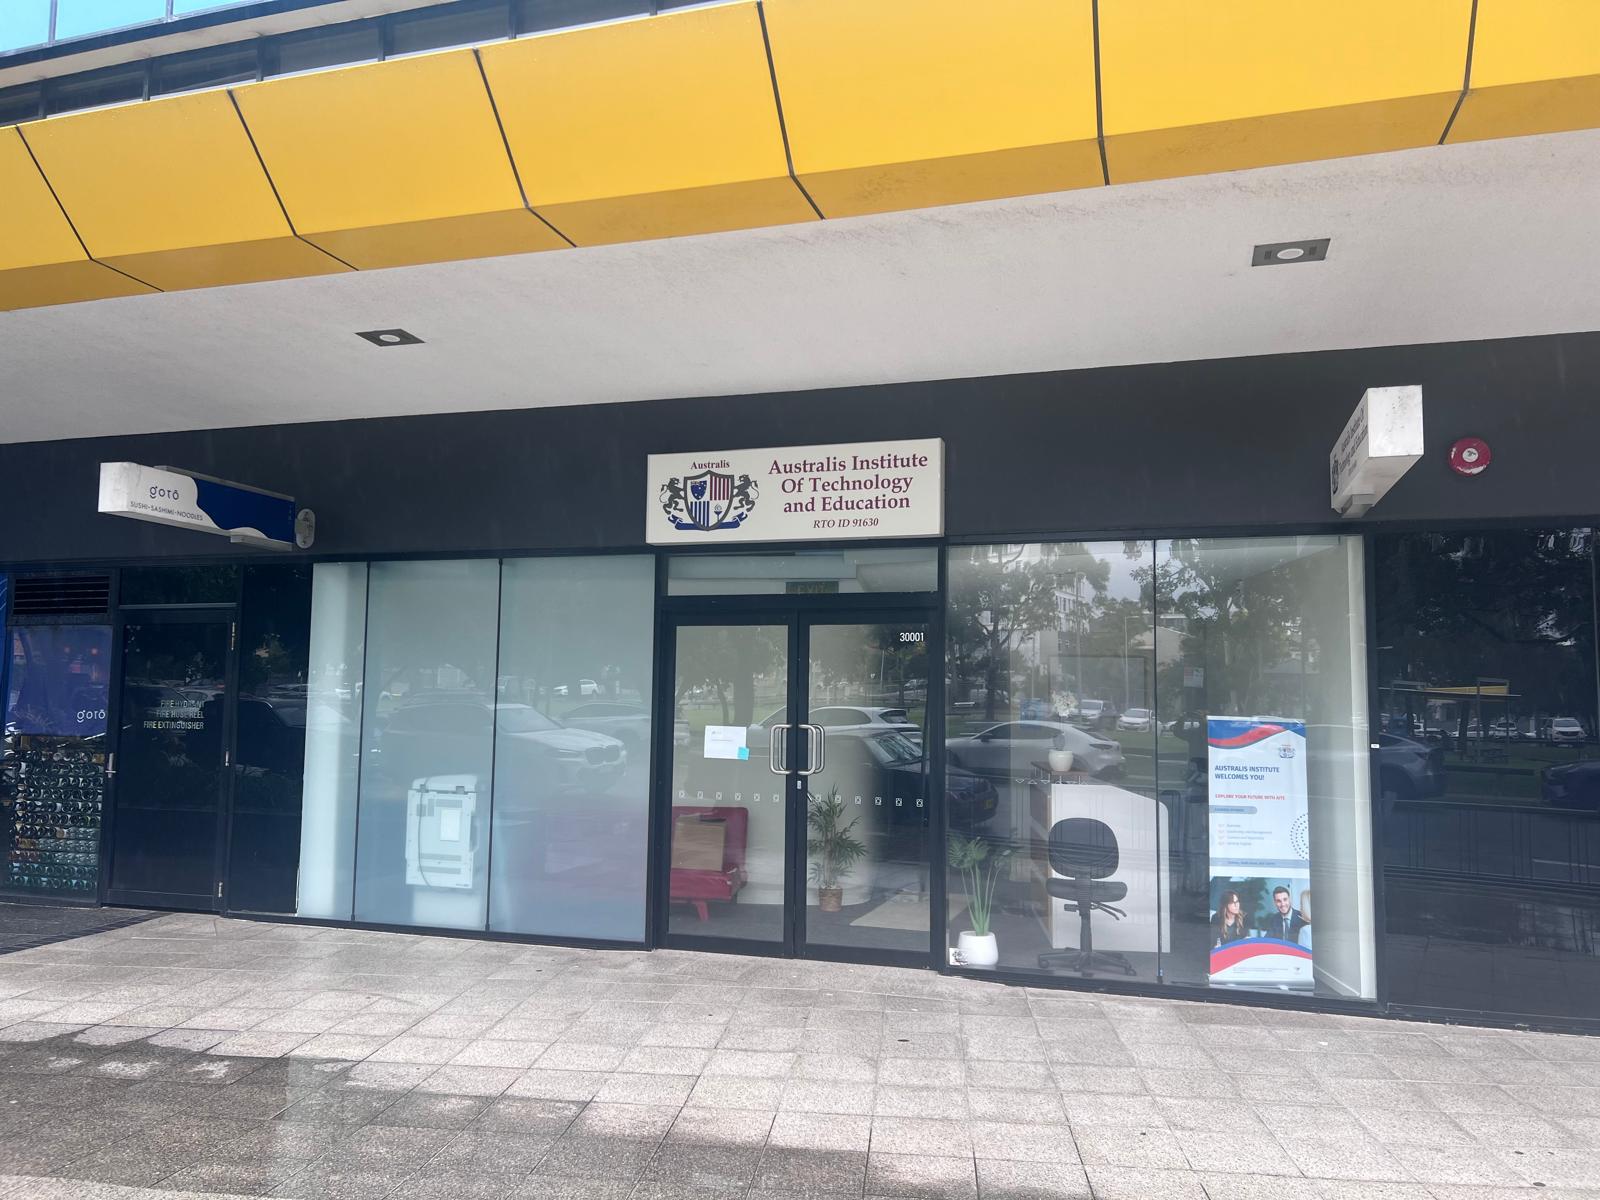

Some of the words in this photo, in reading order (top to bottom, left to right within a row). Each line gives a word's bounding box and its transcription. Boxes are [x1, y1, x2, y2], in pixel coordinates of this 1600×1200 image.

[690, 460, 730, 470] Australis
[768, 457, 846, 474] Australis
[852, 454, 928, 470] Institute
[782, 478, 804, 494] Of
[809, 474, 913, 492] Technology
[784, 498, 815, 512] and
[822, 495, 910, 512] Education
[813, 519, 835, 528] RTO
[838, 519, 850, 528] ID
[852, 518, 879, 527] 91630
[899, 632, 925, 642] 30001
[158, 721, 204, 729] EXTINGUISHER
